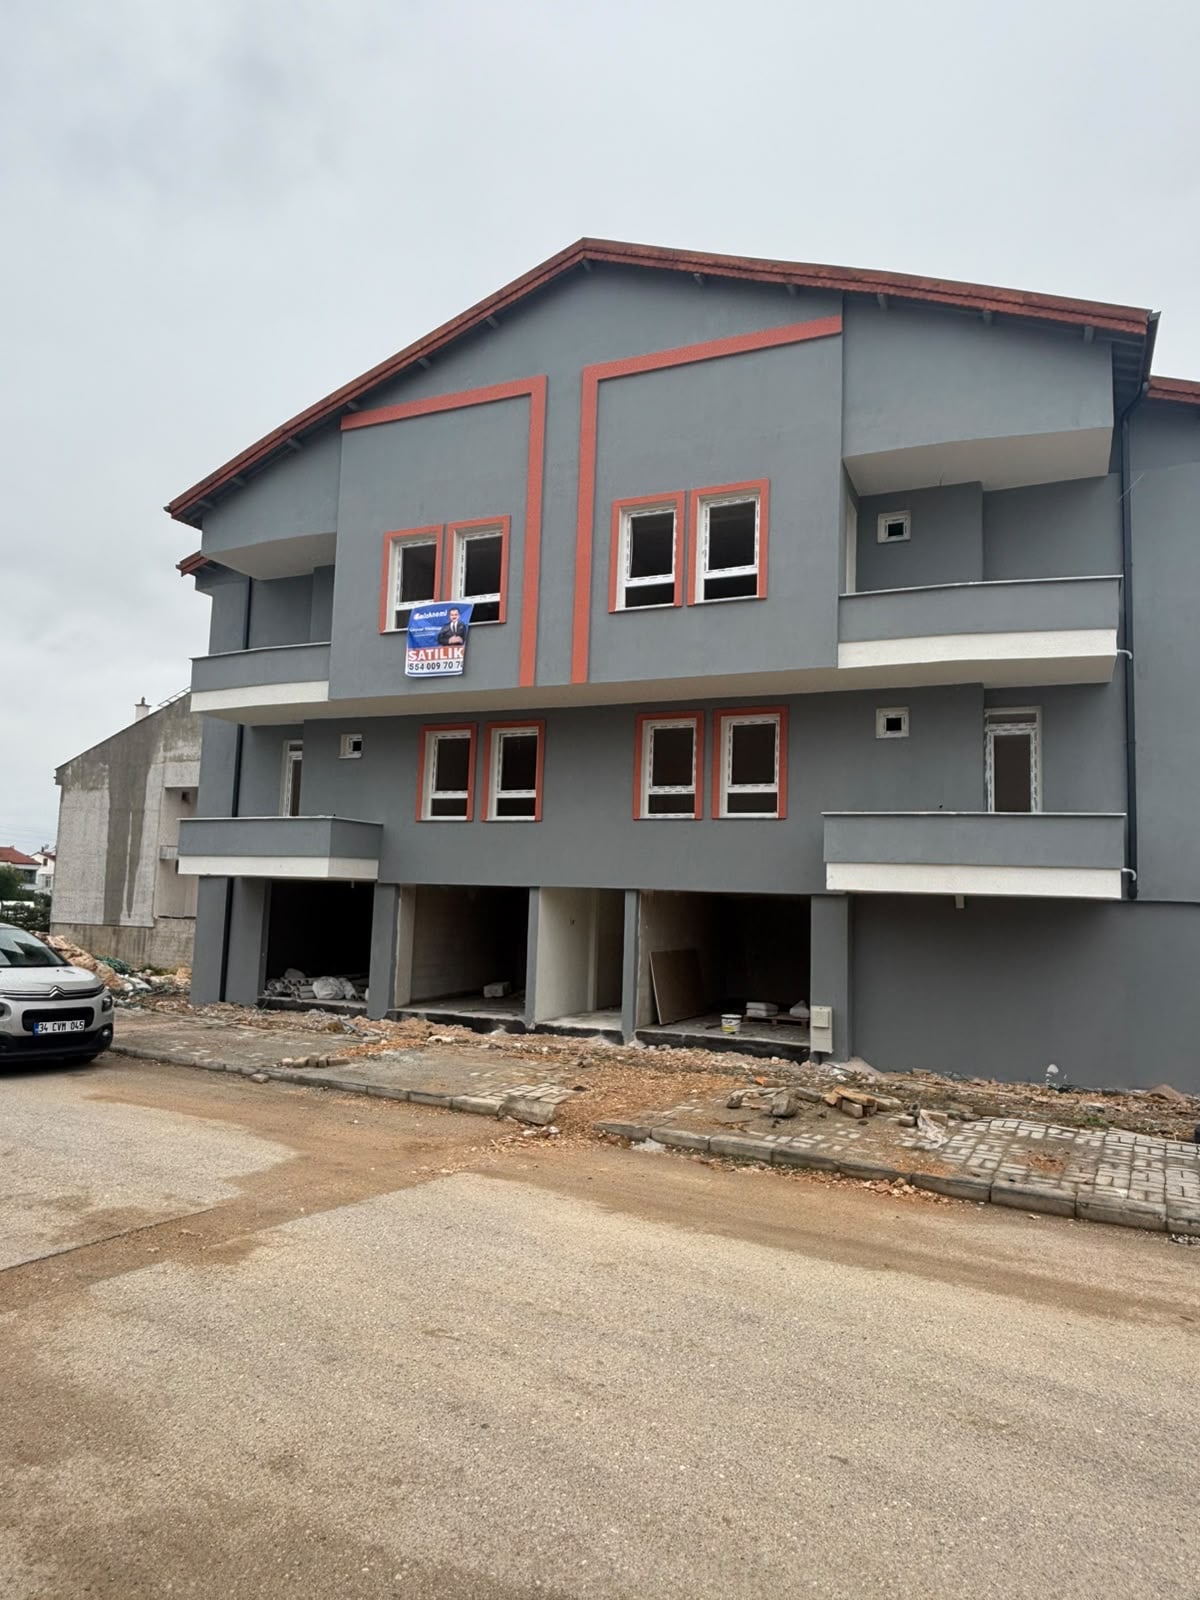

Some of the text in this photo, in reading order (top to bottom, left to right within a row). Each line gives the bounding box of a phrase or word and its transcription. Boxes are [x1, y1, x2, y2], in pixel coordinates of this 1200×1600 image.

[409, 648, 464, 660] SATILIK
[426, 662, 441, 671] 009
[443, 661, 454, 670] 70
[39, 1020, 84, 1032] 34 CVM 045
